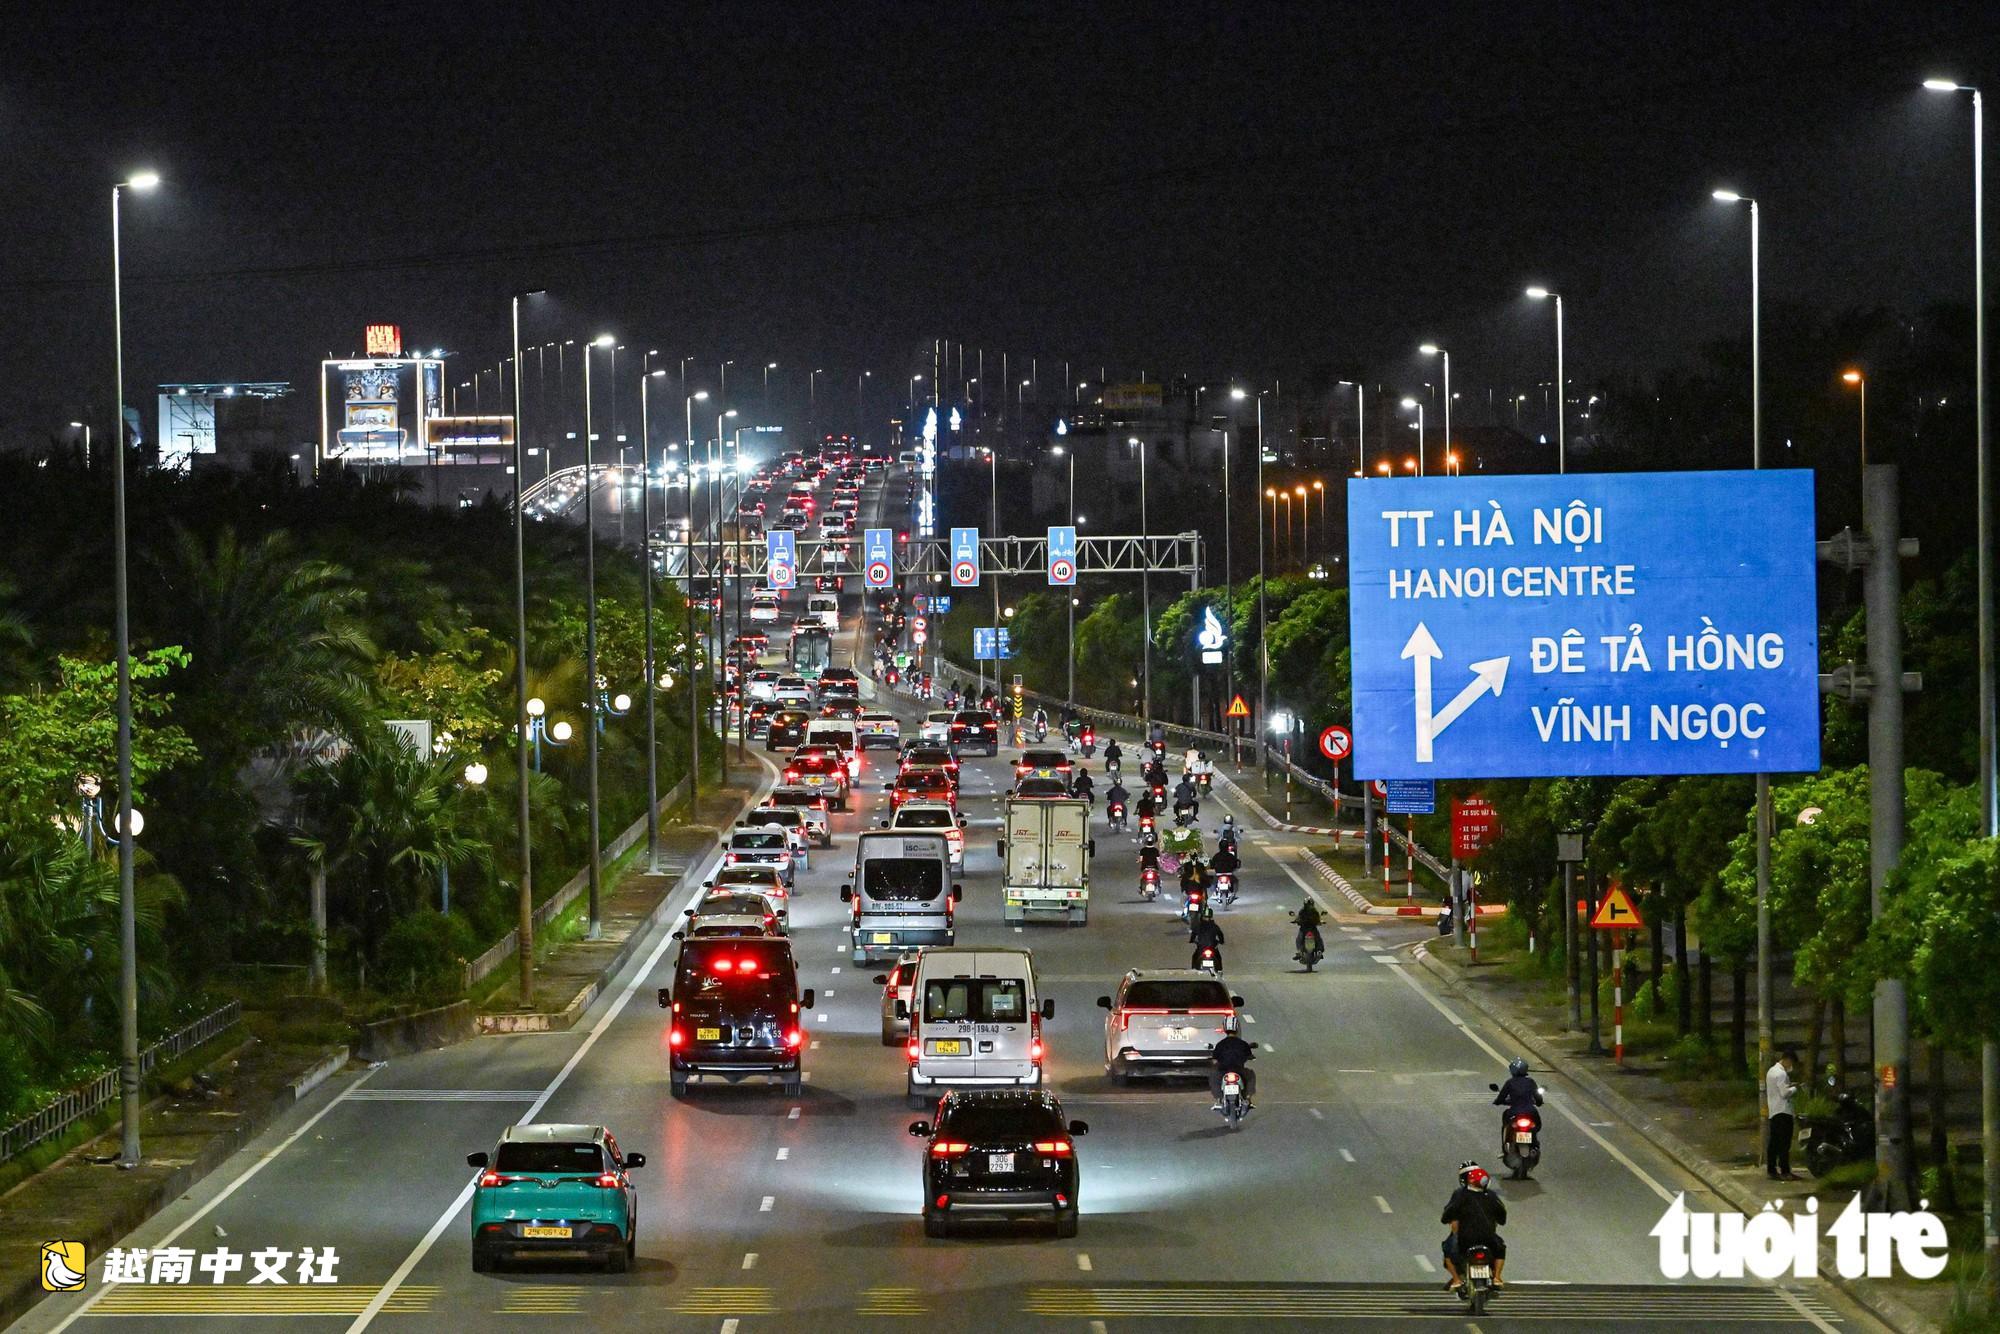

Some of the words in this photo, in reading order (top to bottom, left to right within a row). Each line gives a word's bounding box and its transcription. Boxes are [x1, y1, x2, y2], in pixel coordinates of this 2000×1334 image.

[1533, 499, 1603, 553] NỘI
[776, 569, 787, 580] 80
[873, 570, 884, 579] 80
[960, 568, 971, 578] 80
[1057, 567, 1068, 576] 40
[1388, 567, 1495, 600] HANOI
[1501, 564, 1636, 598] CENTRE
[1529, 627, 1586, 674] ĐÊ
[1599, 623, 1652, 673] TẢ
[1667, 616, 1785, 672] HỒNG
[1531, 697, 1631, 743] VĨNH
[1650, 702, 1767, 749] NGỌC
